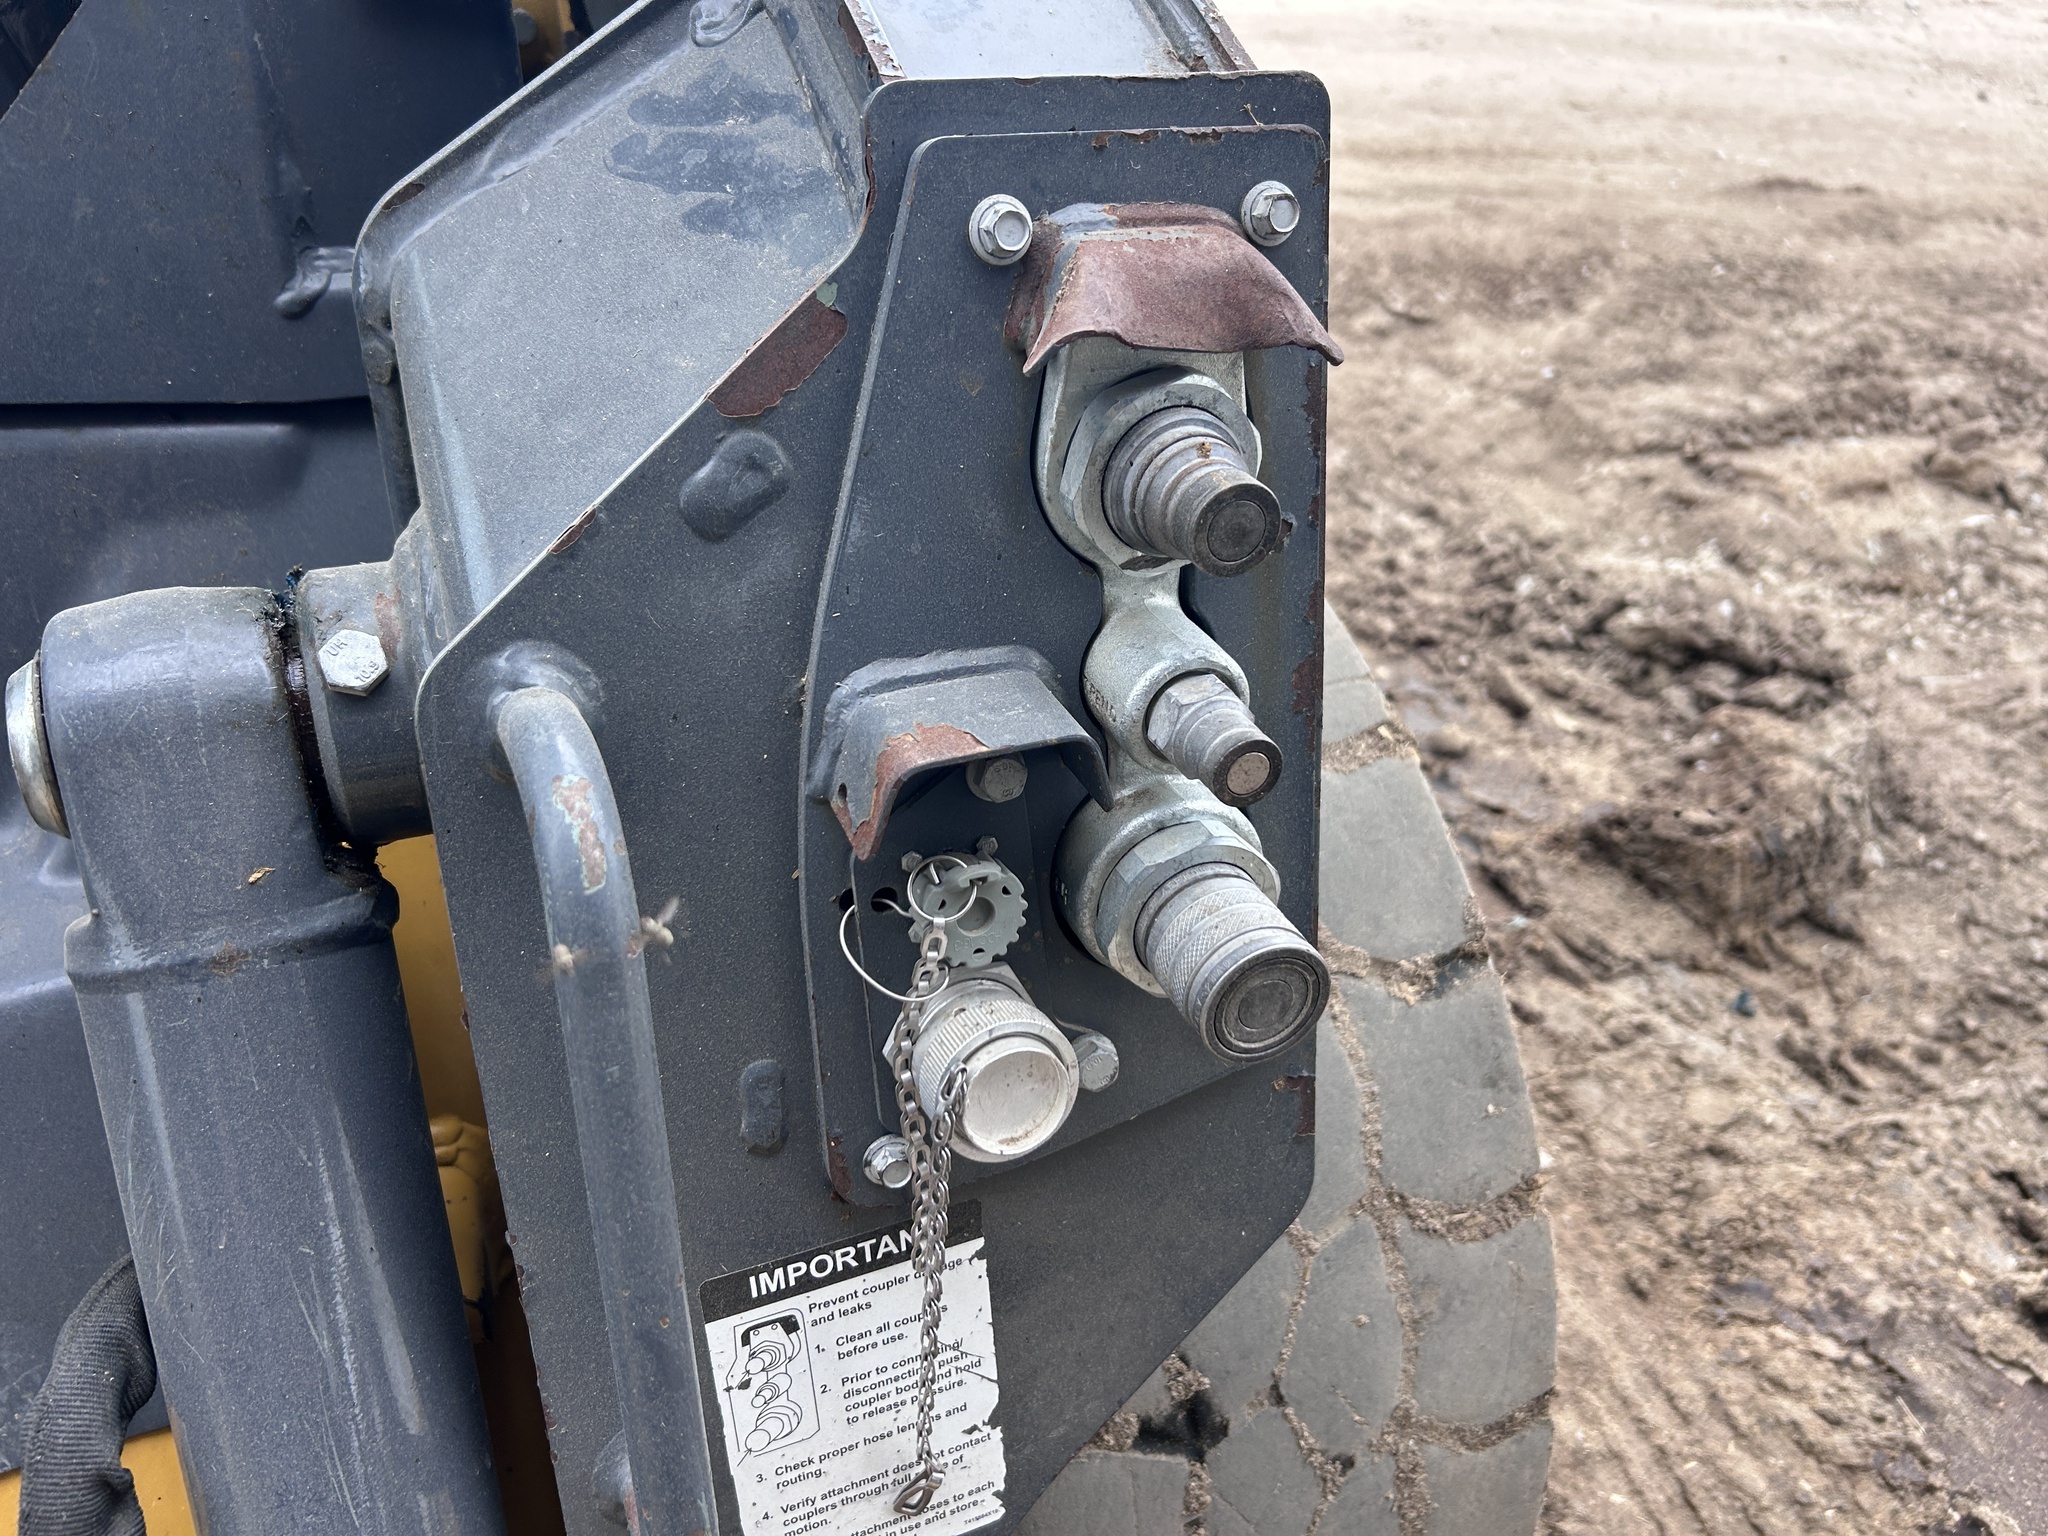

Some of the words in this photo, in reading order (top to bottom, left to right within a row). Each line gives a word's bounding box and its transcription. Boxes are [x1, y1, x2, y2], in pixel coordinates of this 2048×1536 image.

[750, 1226, 923, 1298] IMPORTAN
[808, 1290, 859, 1313] Prevent
[862, 1274, 911, 1296] coupler
[914, 1258, 962, 1279] dage
[811, 1312, 835, 1327] and
[838, 1301, 872, 1318] leaks
[815, 1344, 826, 1354] 1.
[836, 1328, 872, 1346] Clean
[876, 1321, 890, 1334] all
[894, 1304, 948, 1328] coupls
[820, 1384, 831, 1394] 2.
[841, 1370, 872, 1386] Prior
[875, 1365, 888, 1375] to
[892, 1337, 963, 1369] connting/
[838, 1342, 878, 1360] before
[882, 1332, 908, 1346] use.
[938, 1352, 968, 1369] push
[845, 1389, 892, 1412] coupler
[895, 1379, 925, 1395] bod
[933, 1368, 952, 1382] nd
[955, 1358, 982, 1375] hold
[846, 1416, 859, 1425] to
[863, 1399, 907, 1419] release
[911, 1379, 967, 1405] pssure.
[756, 1473, 767, 1483] 3.
[775, 1457, 815, 1476] Check
[818, 1441, 860, 1463] proper
[863, 1430, 893, 1446] hose
[897, 1413, 941, 1434] lens
[945, 1402, 967, 1417] and
[762, 1511, 773, 1520] 4.
[780, 1496, 817, 1514] Verify
[820, 1470, 889, 1500] attachment
[892, 1460, 921, 1474] does
[948, 1432, 991, 1455] contact
[776, 1468, 826, 1489] routing.
[783, 1502, 837, 1526] couplers
[840, 1482, 889, 1506] through
[892, 1473, 911, 1486] full
[952, 1454, 964, 1465] of
[784, 1518, 832, 1536] motion.
[850, 1514, 912, 1536] ttachment
[921, 1498, 949, 1514] oses
[952, 1493, 965, 1502] to
[968, 1480, 995, 1496] each
[900, 1522, 921, 1534] use
[925, 1510, 946, 1525] and
[949, 1499, 979, 1515] store
